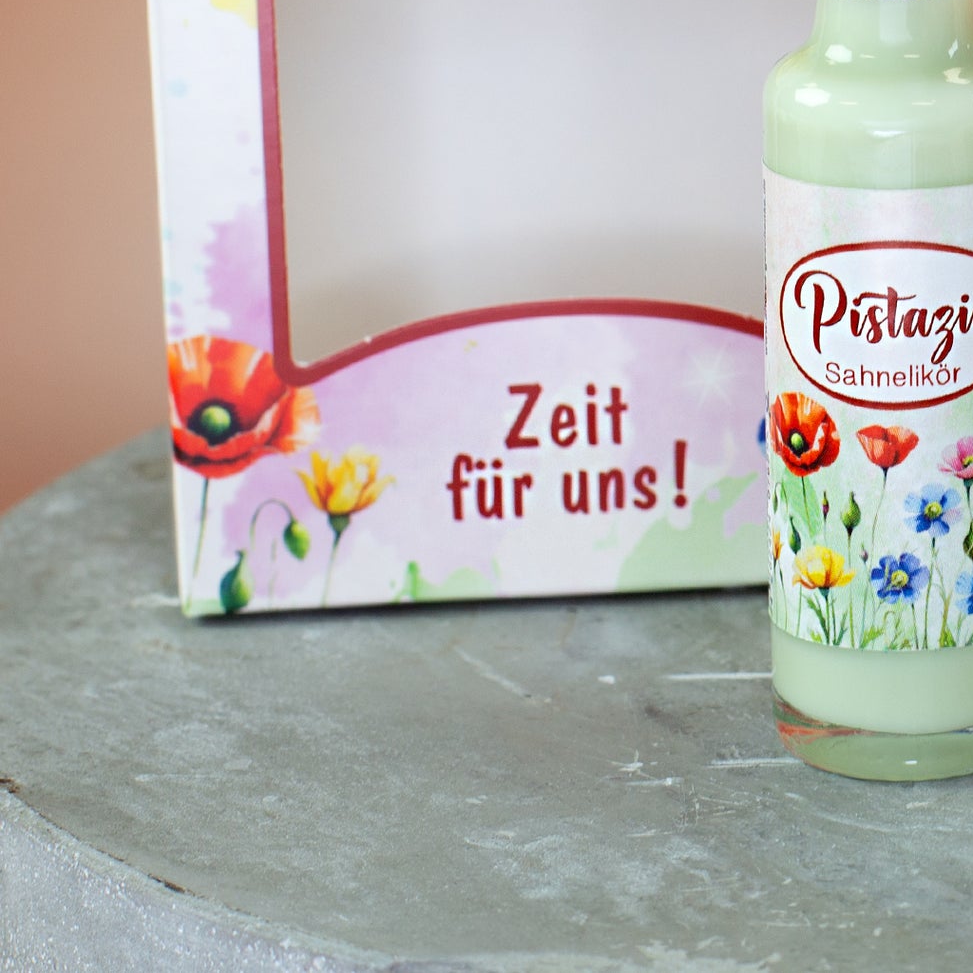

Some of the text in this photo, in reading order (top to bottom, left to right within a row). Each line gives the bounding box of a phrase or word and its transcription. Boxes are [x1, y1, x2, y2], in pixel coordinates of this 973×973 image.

[825, 362, 961, 387] Sahnelikör
[505, 382, 627, 449] Zeit
[446, 438, 687, 521] für uns!
